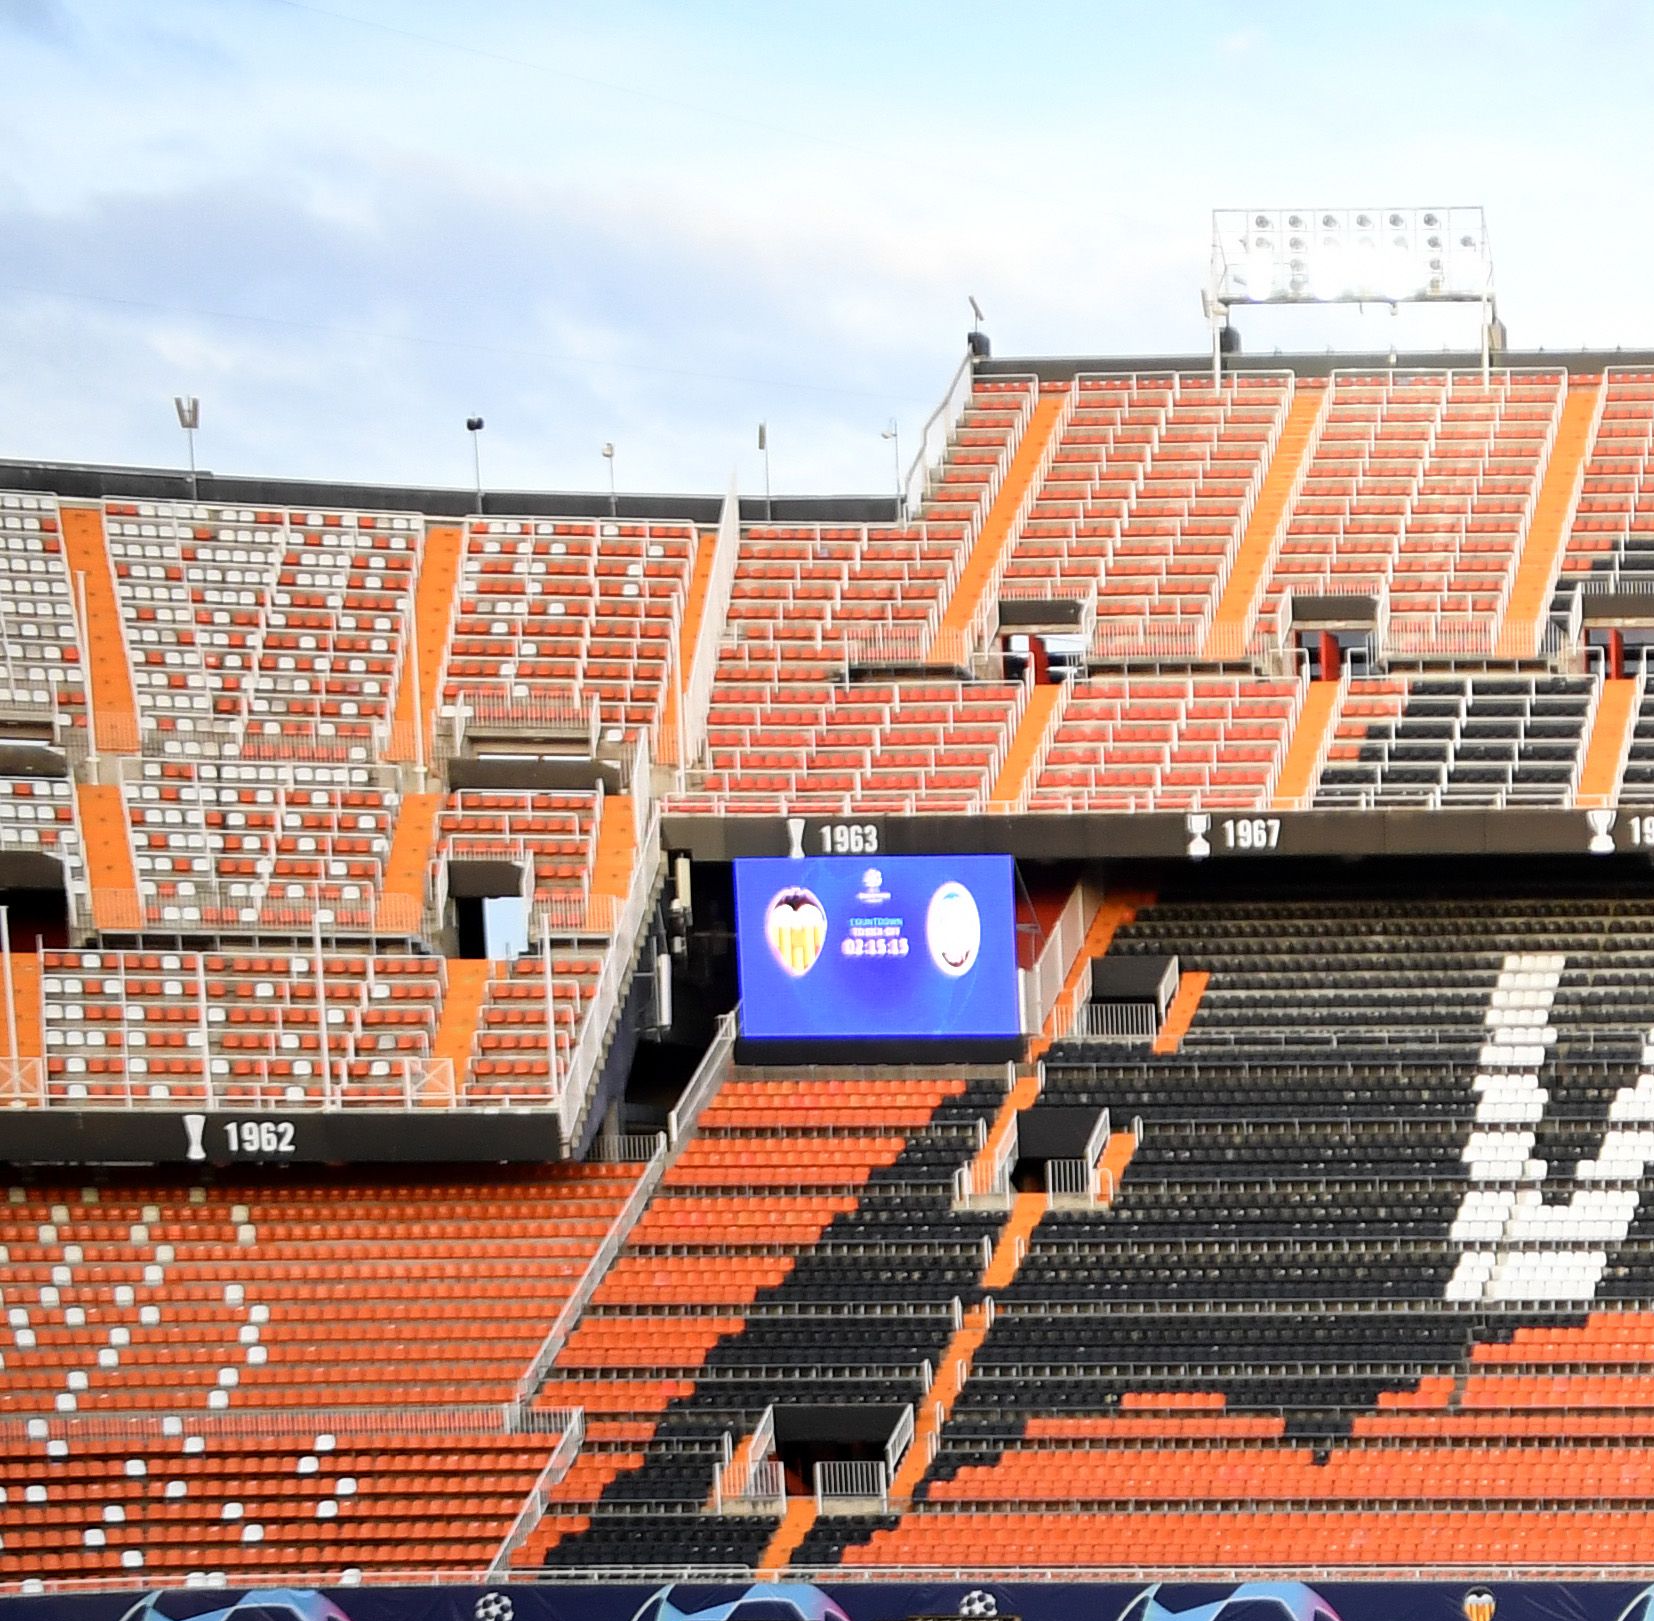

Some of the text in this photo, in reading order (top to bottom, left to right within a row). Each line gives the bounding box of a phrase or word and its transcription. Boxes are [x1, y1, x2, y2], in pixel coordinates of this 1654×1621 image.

[819, 824, 879, 853] 1963
[1223, 818, 1282, 849] 1967
[224, 1121, 296, 1153] 1962
